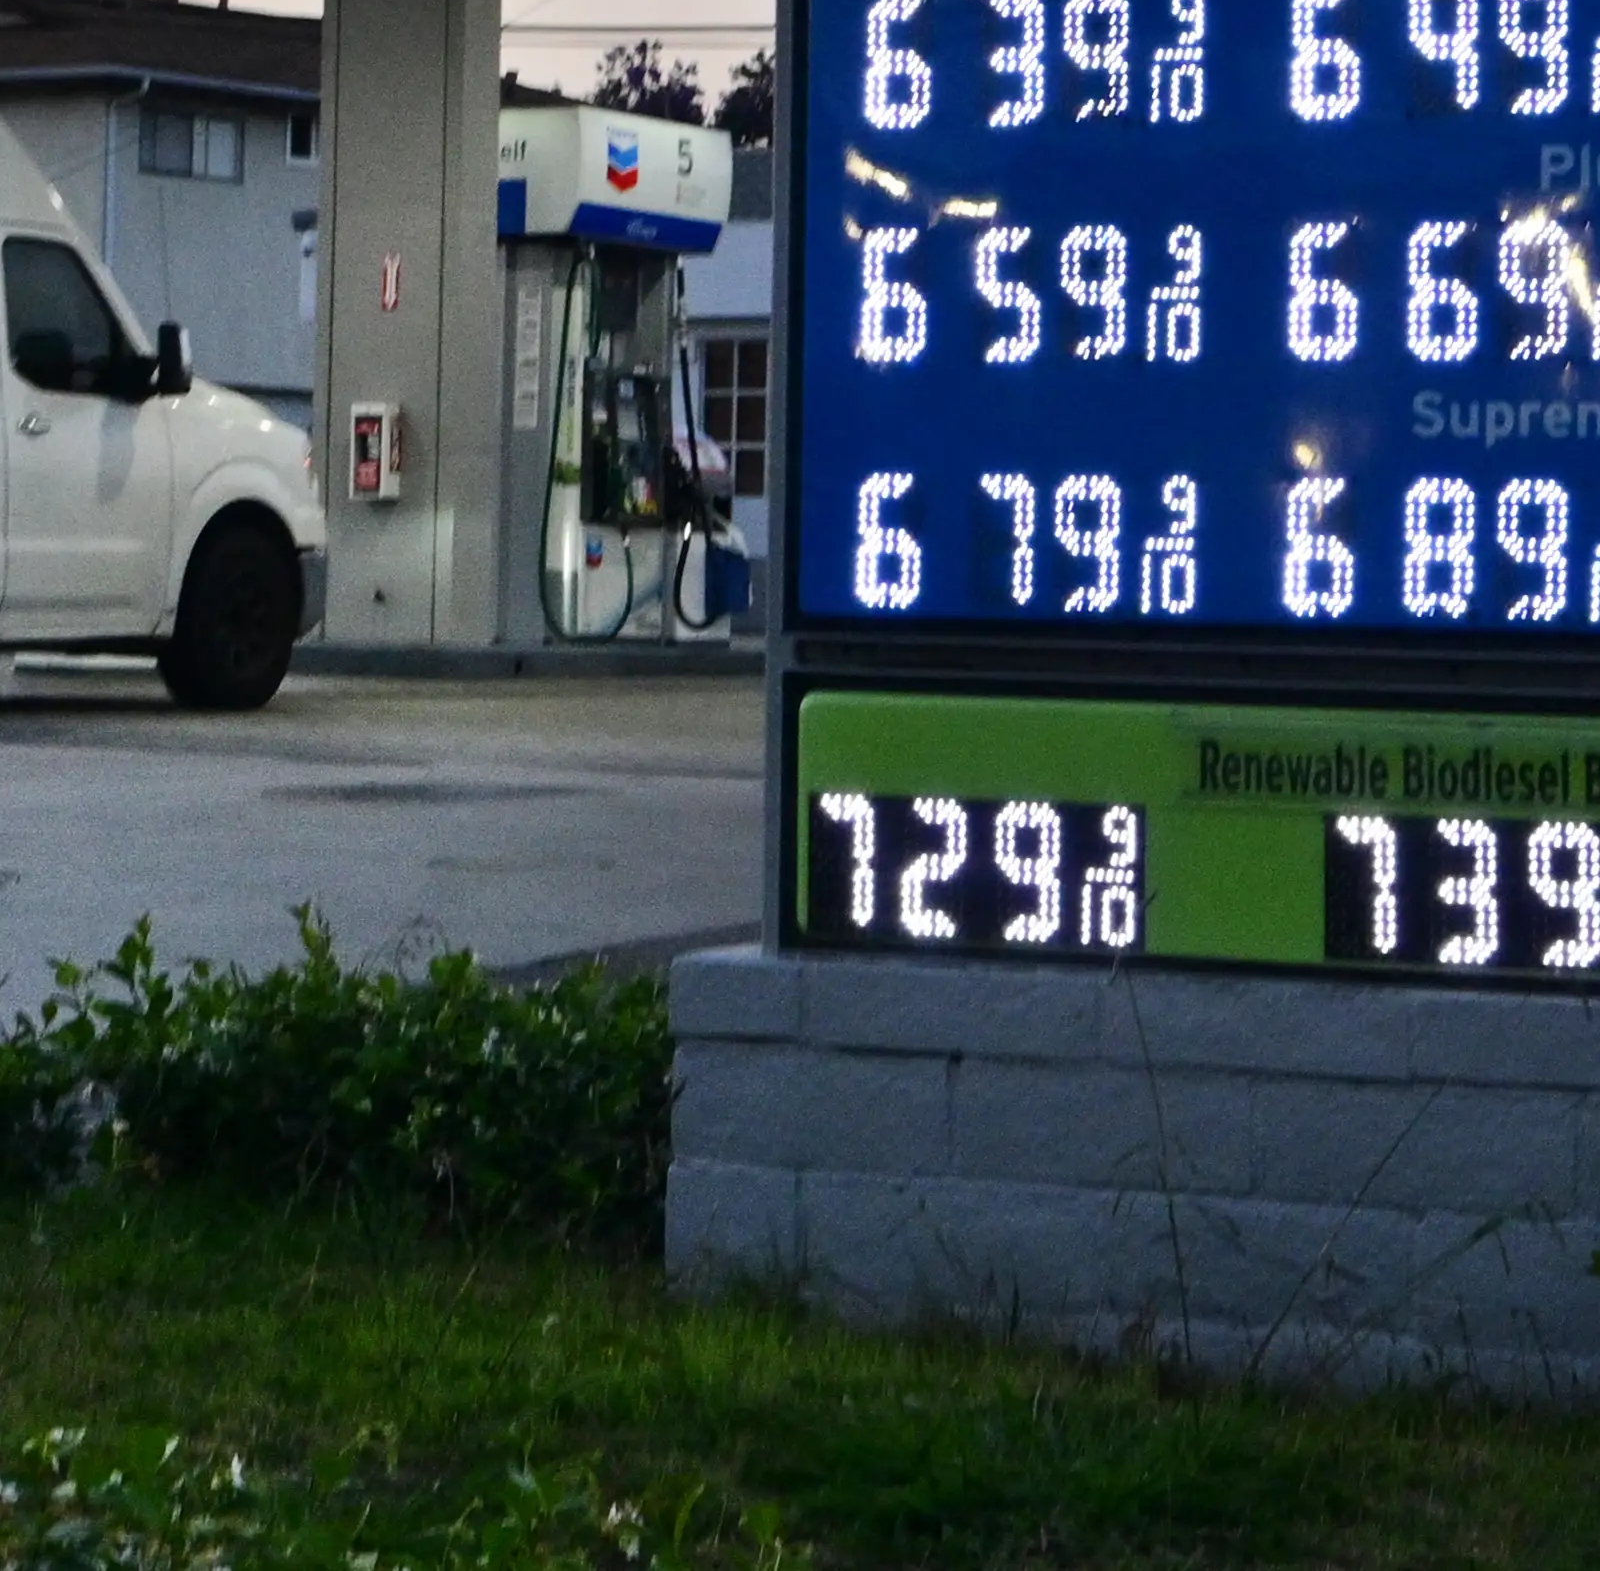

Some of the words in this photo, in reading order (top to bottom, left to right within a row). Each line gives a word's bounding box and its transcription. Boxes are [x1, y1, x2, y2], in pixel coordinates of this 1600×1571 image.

[678, 139, 693, 176] 5
[1199, 740, 1388, 799] Renewable
[1403, 746, 1571, 804] Biodiesel
